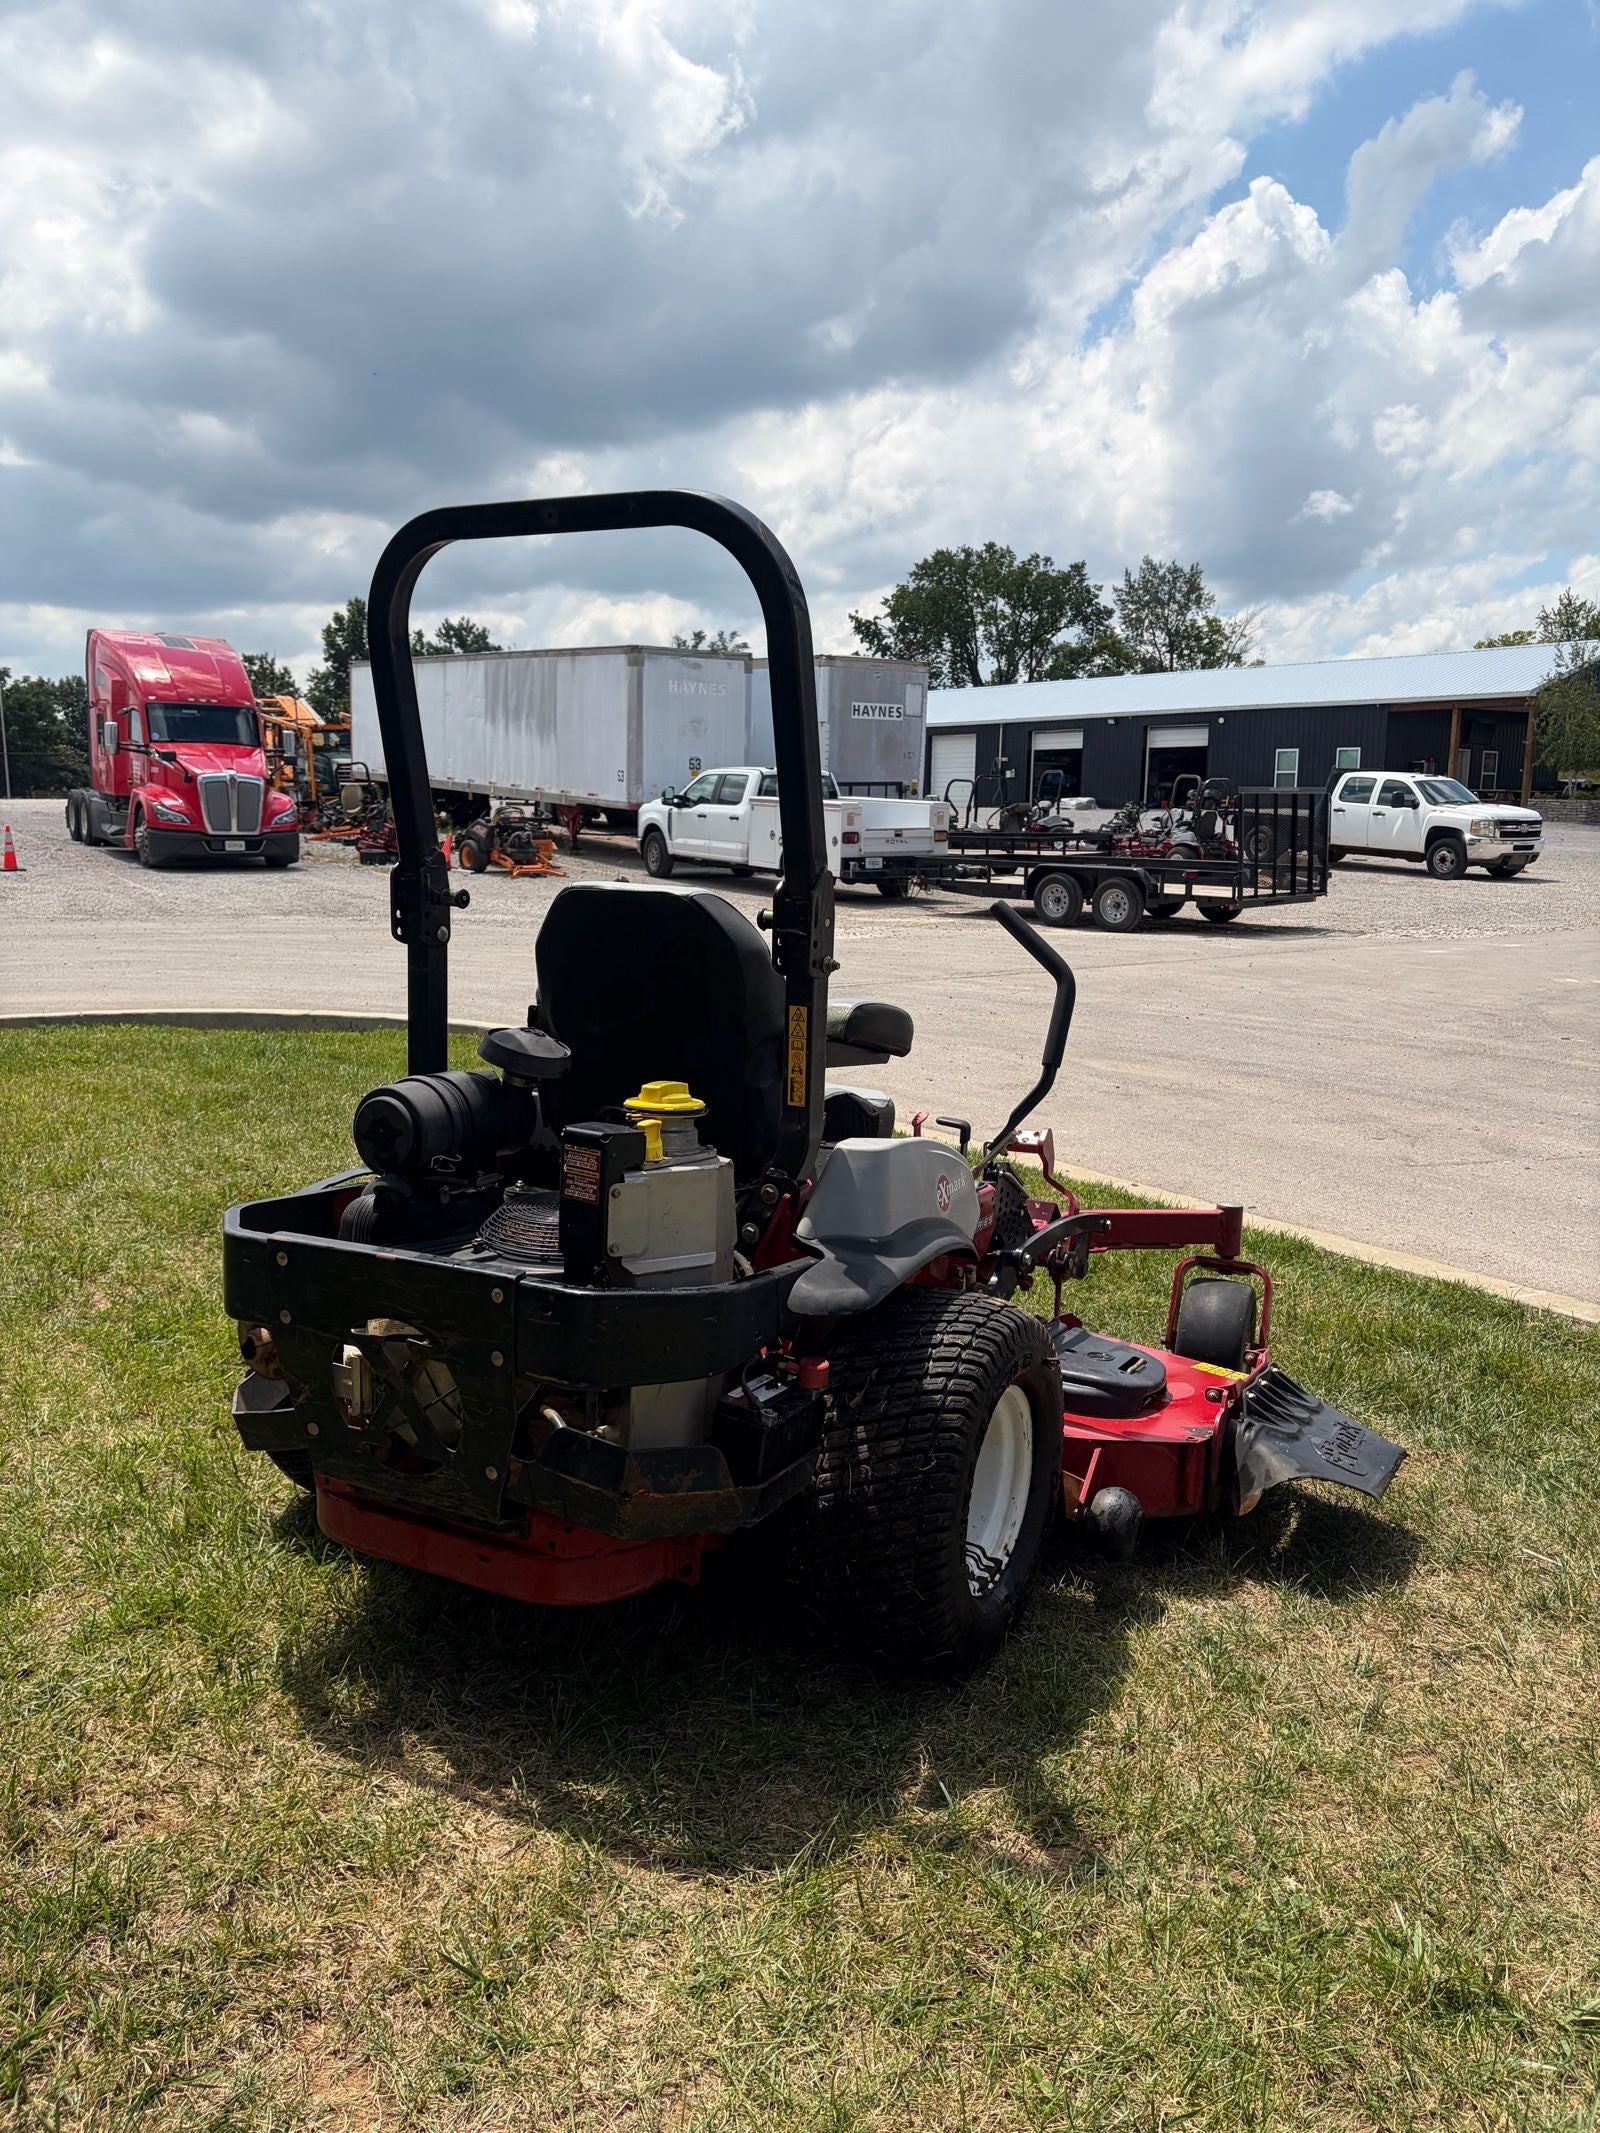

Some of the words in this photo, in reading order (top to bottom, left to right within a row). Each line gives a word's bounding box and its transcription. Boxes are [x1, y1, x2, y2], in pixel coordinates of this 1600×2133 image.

[669, 680, 726, 696] HAYNES
[852, 705, 902, 718] HAYNES
[688, 757, 701, 770] 53
[617, 770, 625, 782] 53
[937, 1171, 966, 1207] eXmark
[976, 1216, 993, 1232] RIES
